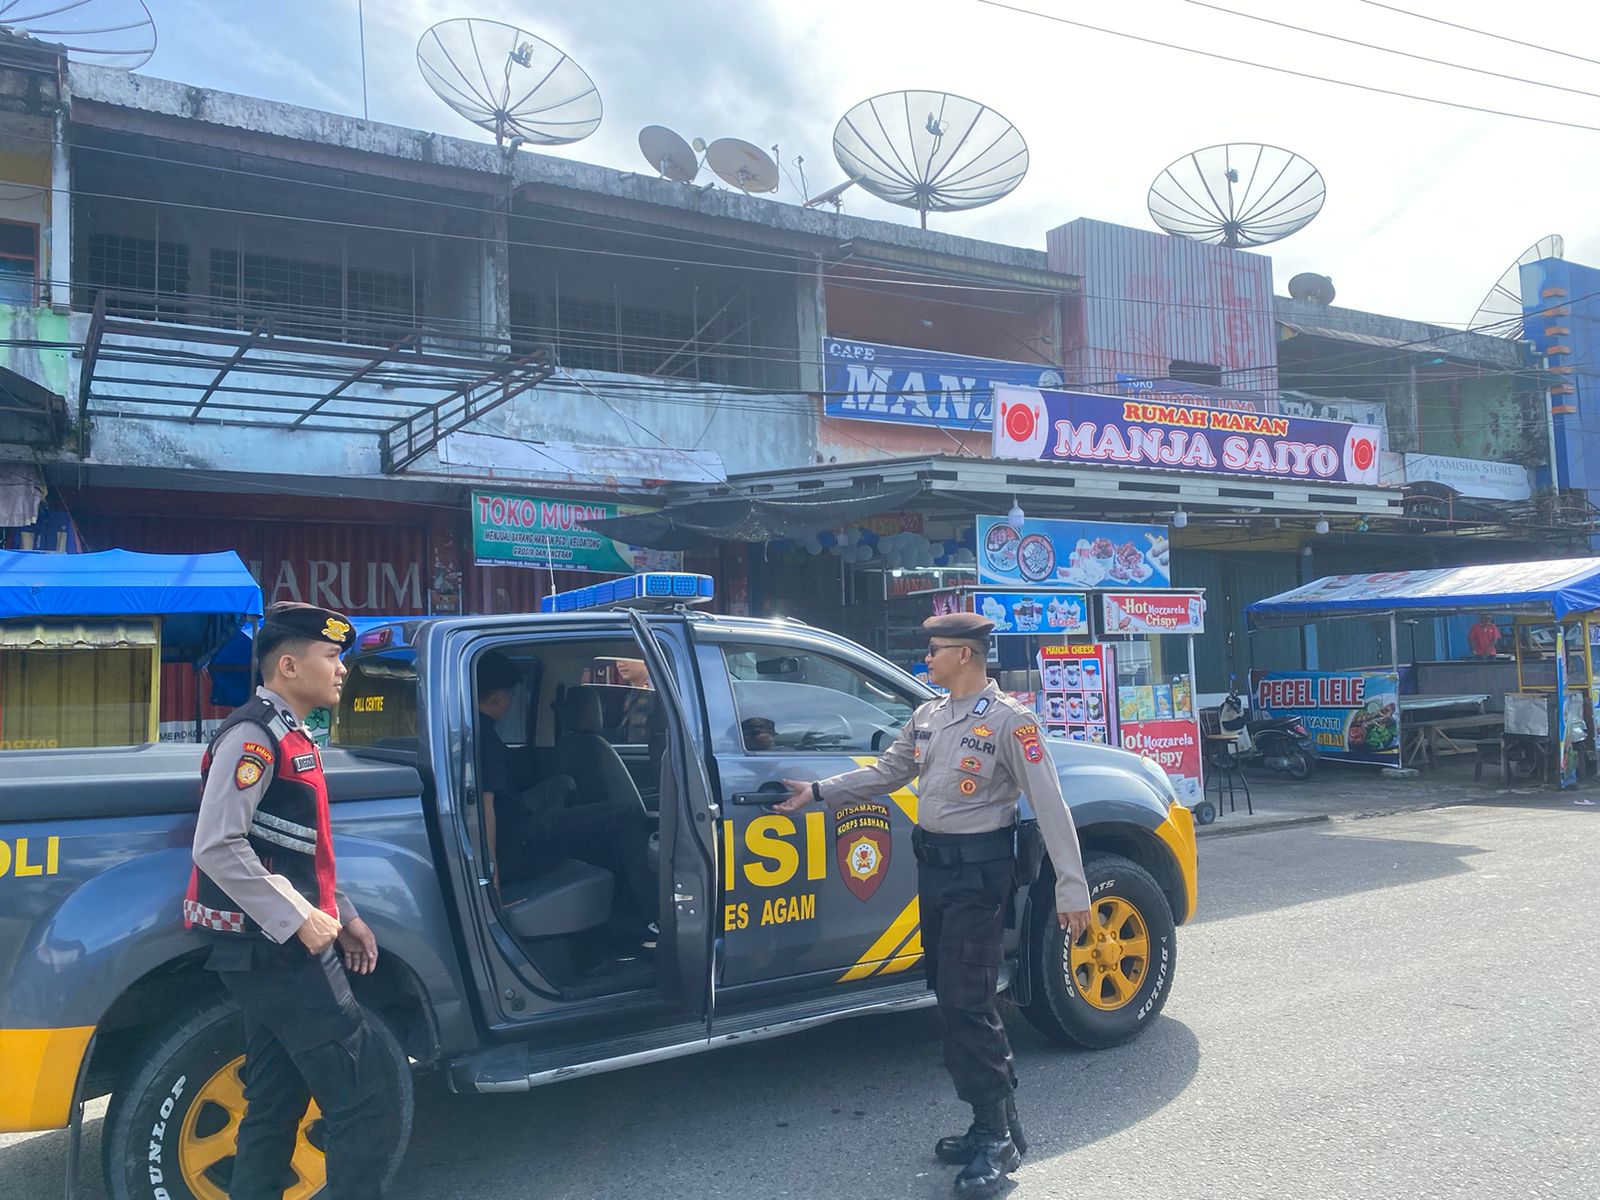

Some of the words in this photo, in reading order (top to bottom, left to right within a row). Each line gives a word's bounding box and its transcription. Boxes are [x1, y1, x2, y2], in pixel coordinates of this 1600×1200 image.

[829, 343, 875, 361] CAFE
[841, 364, 994, 422] MANJ
[1123, 401, 1208, 427] RUMAH
[1210, 411, 1288, 436] MAKAN
[1054, 420, 1217, 467] MANJA
[1222, 436, 1340, 478] SAIYO
[1429, 459, 1480, 473] MAMISHA
[1483, 464, 1514, 476] STORE
[477, 496, 536, 528] TOKO
[484, 529, 510, 542] MENJUAL
[1121, 598, 1148, 614] Hot
[1146, 614, 1178, 629] Crispy
[1045, 645, 1070, 655] MANJA
[1072, 645, 1096, 654] CHEESE
[1259, 679, 1317, 709] PECEL
[1318, 677, 1366, 708] LELE
[354, 697, 364, 712] CALL
[365, 696, 384, 712] CENTRE
[1307, 715, 1341, 731] YANTI
[960, 736, 996, 756] POLRI
[836, 804, 888, 820] DITSAMAPTA
[837, 820, 858, 836] KORPS
[859, 818, 889, 831] SABHARA
[761, 894, 816, 926] AGAM
[1137, 947, 1169, 1020] DUNLOP
